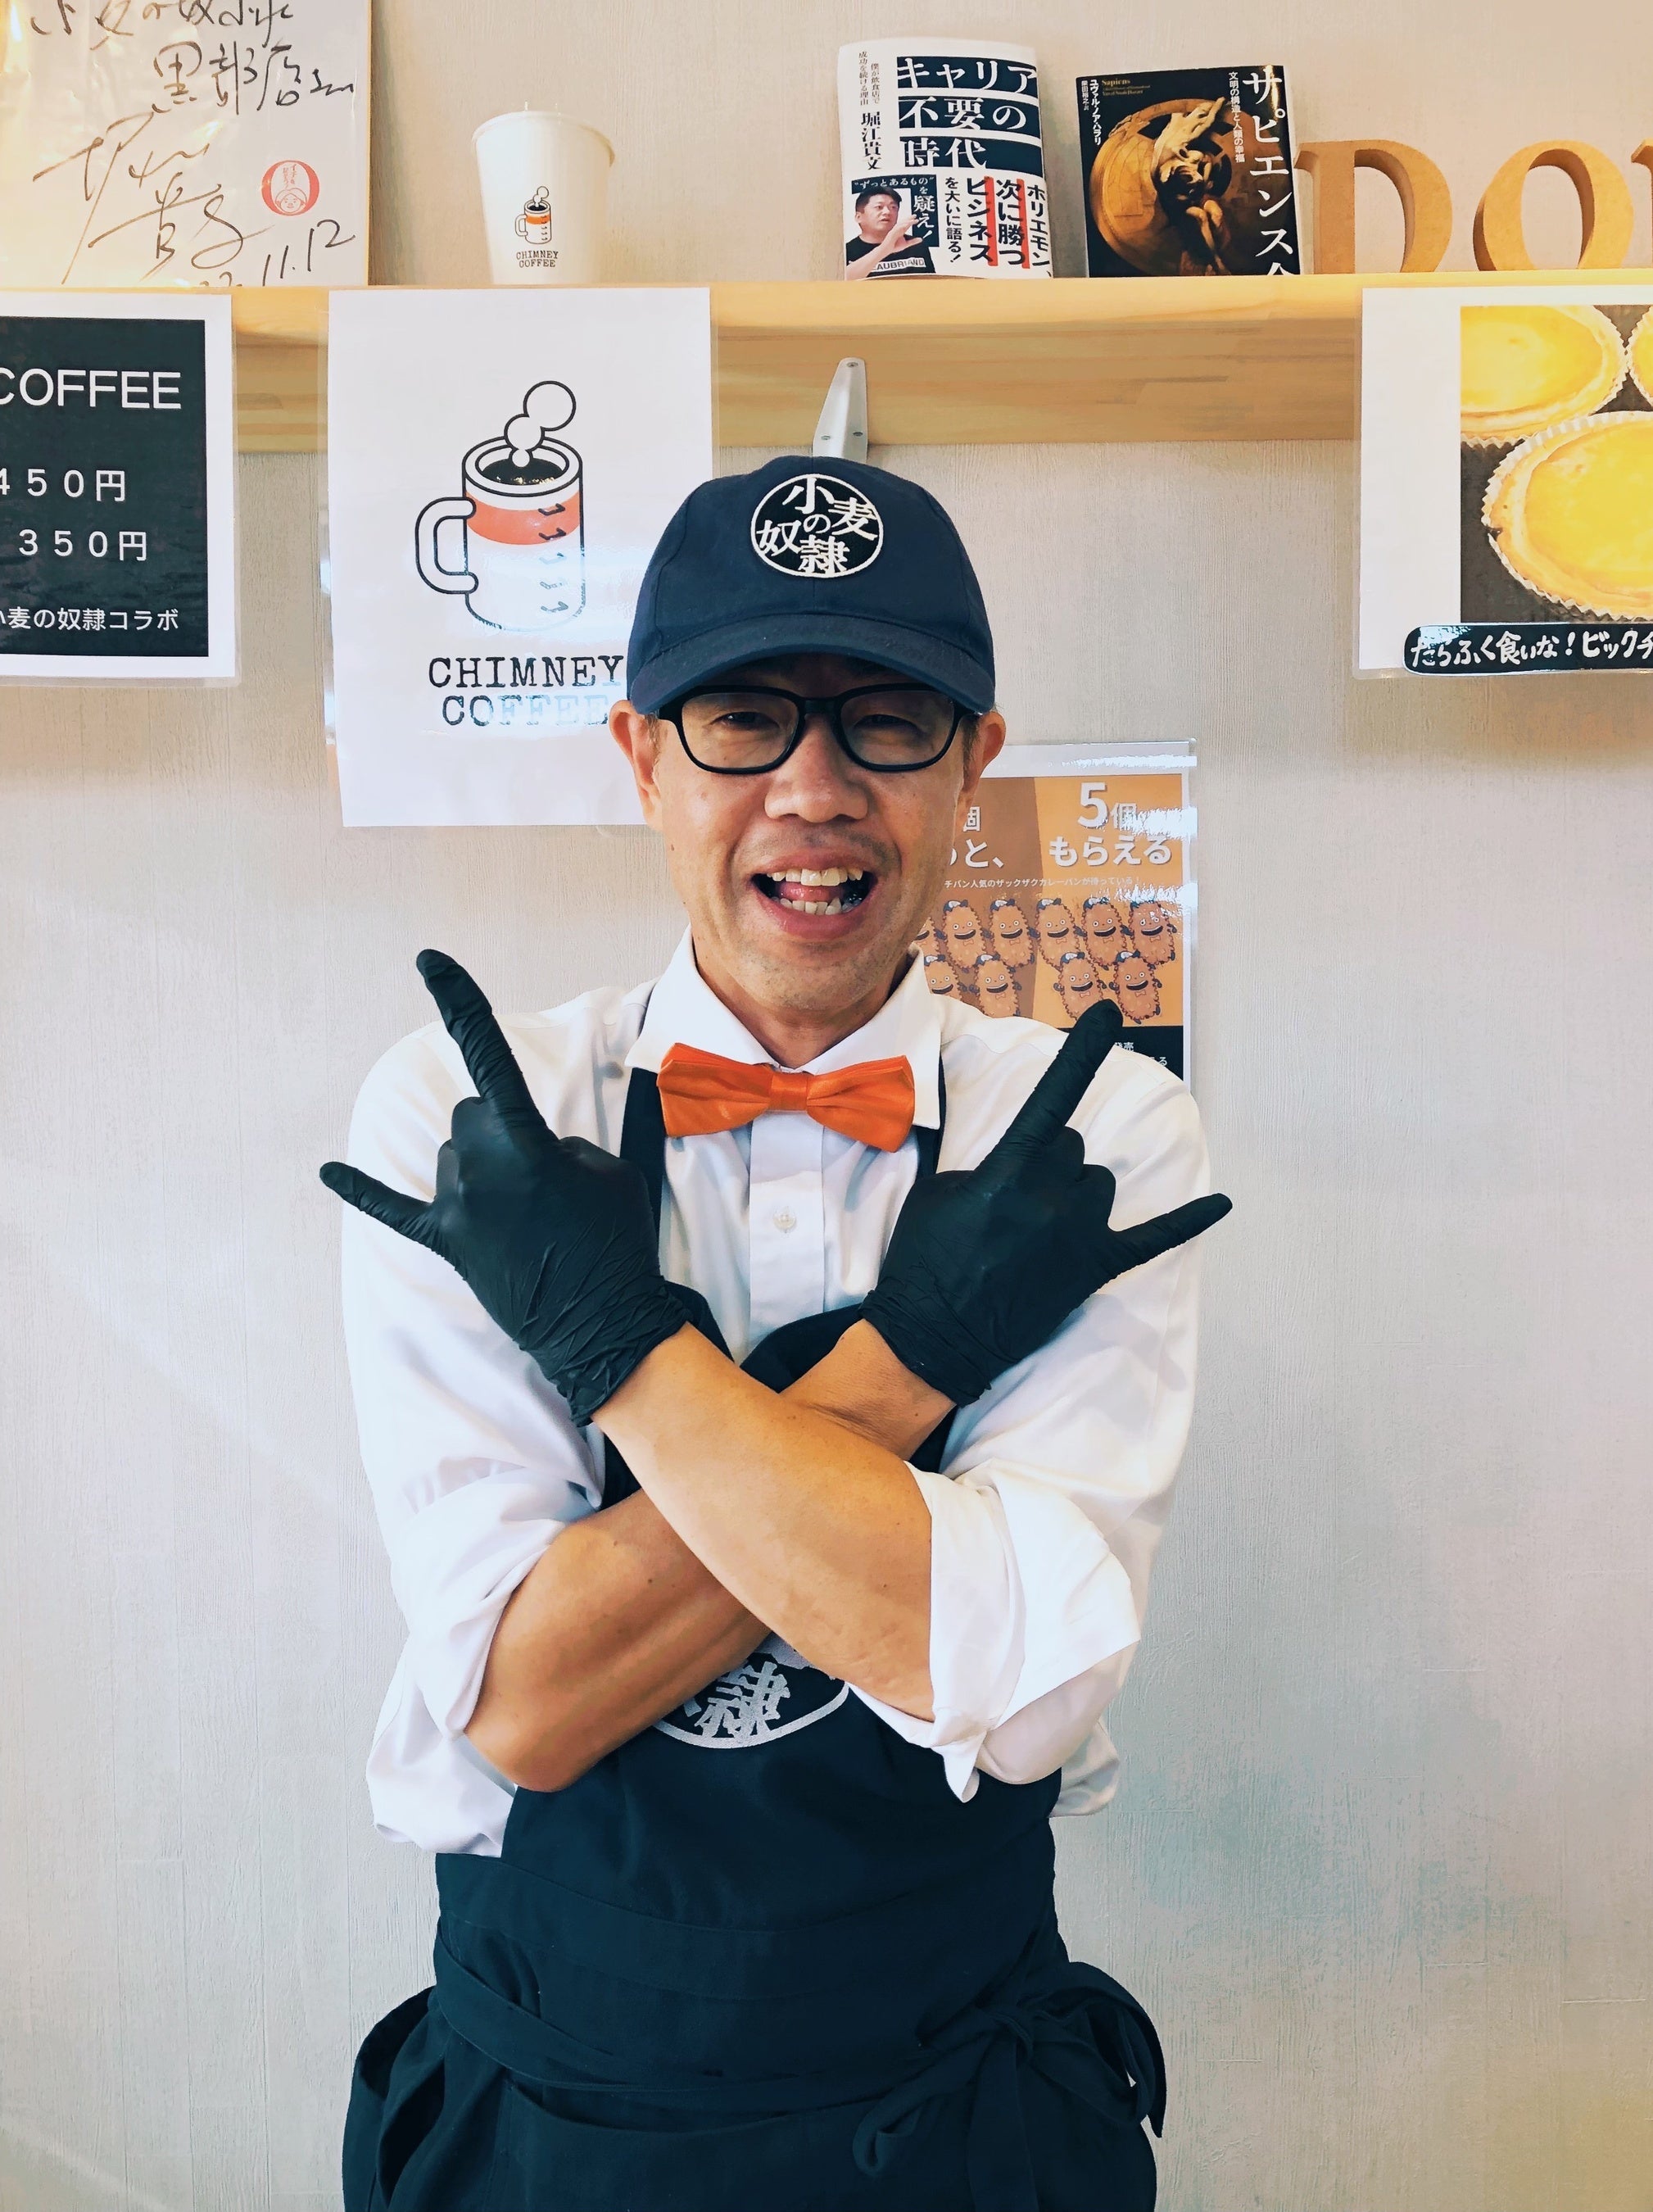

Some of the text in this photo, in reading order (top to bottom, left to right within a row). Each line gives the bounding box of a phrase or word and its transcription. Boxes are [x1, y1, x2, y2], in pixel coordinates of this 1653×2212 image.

[898, 57, 1037, 93] キャリア
[899, 96, 1026, 130] 不要の
[861, 111, 881, 170] 堀江貴文
[900, 137, 986, 169] 時代
[996, 179, 1026, 265] 次に勝つ
[516, 250, 559, 260] CHIMNEY
[519, 259, 556, 268] COFFEE
[428, 655, 624, 687] CHIMNEY
[442, 695, 608, 726] COFFEE
[950, 838, 1004, 868] と、
[1049, 835, 1172, 867] もらえる
